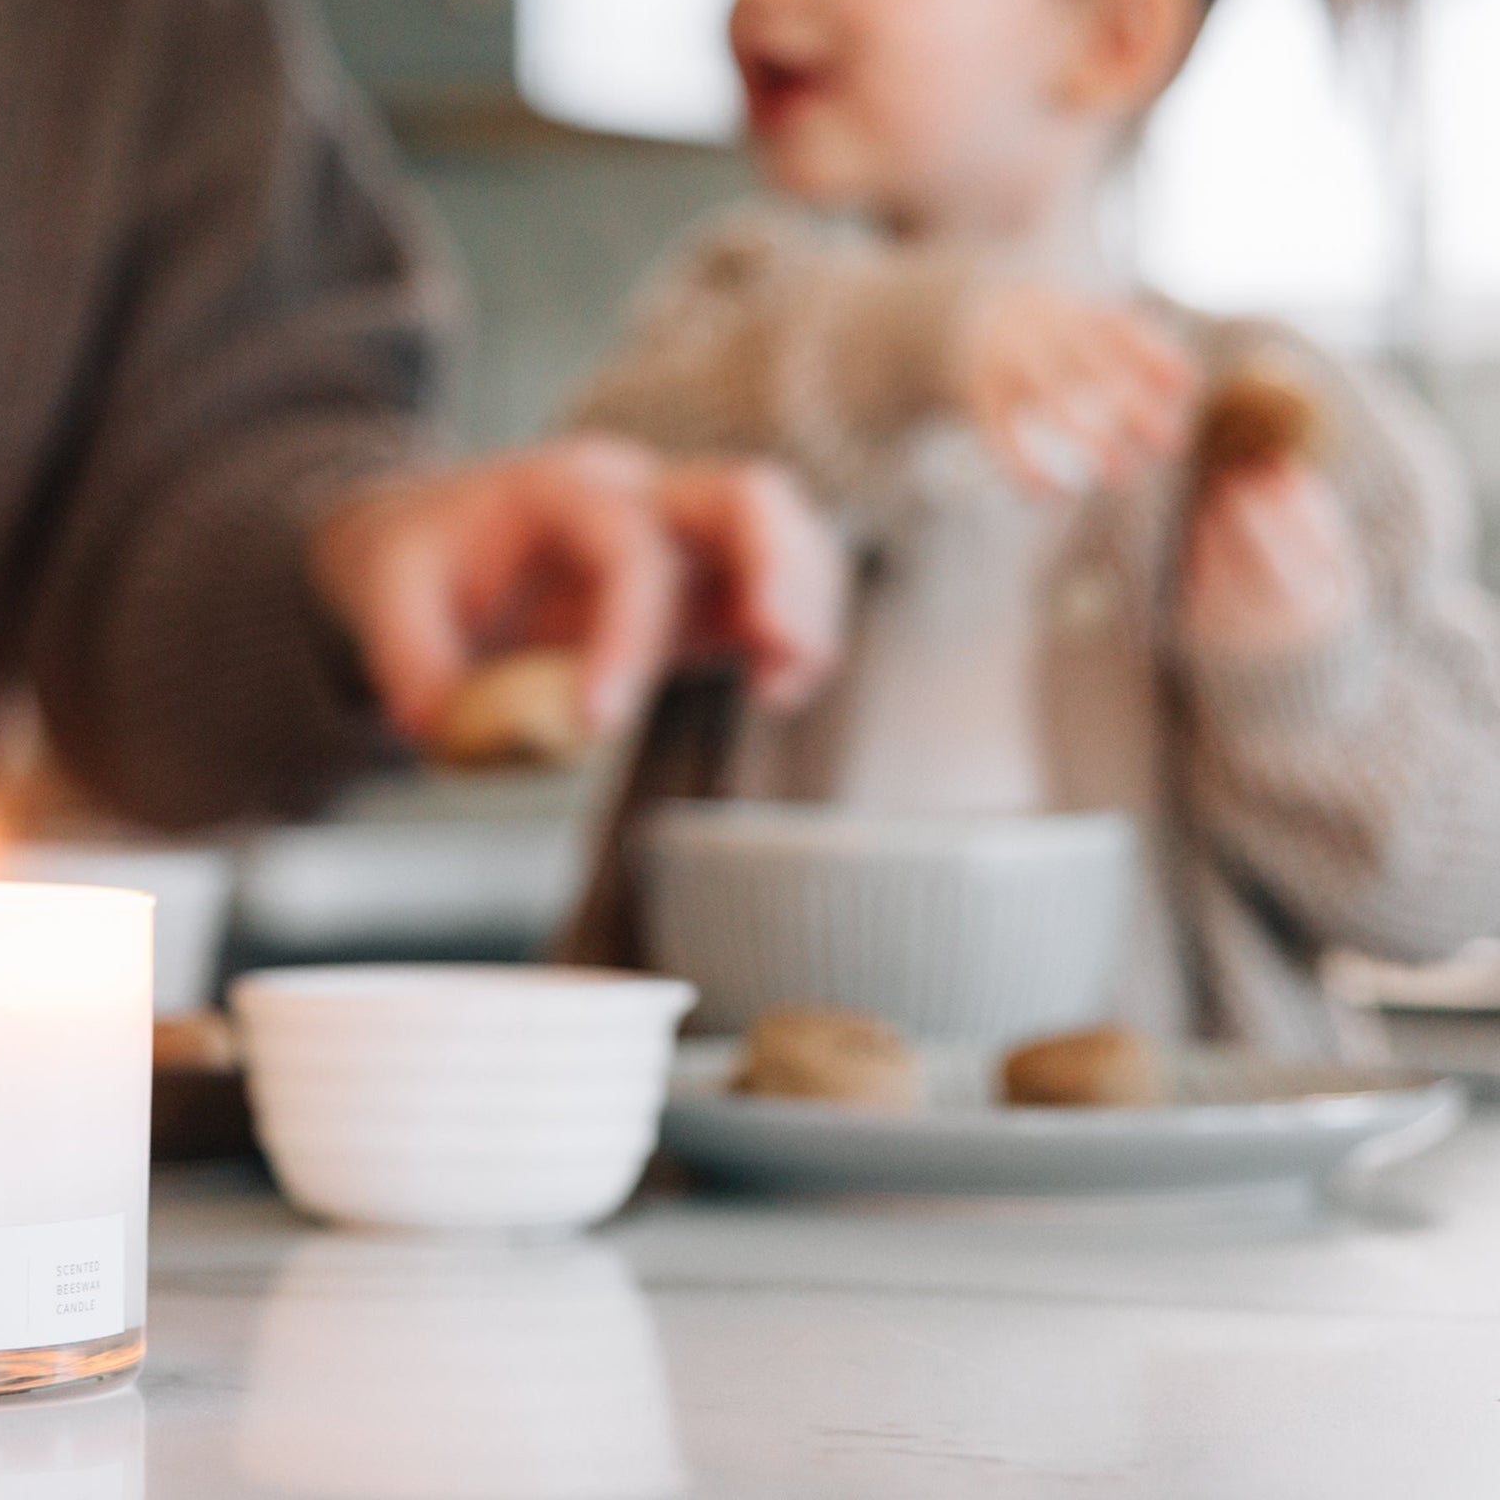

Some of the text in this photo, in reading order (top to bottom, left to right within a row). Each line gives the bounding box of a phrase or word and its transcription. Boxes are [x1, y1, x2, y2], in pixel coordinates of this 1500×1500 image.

[56, 1260, 100, 1277] SCENTED
[56, 1280, 100, 1296] BEESWAX
[56, 1299, 96, 1315] CANDLE
